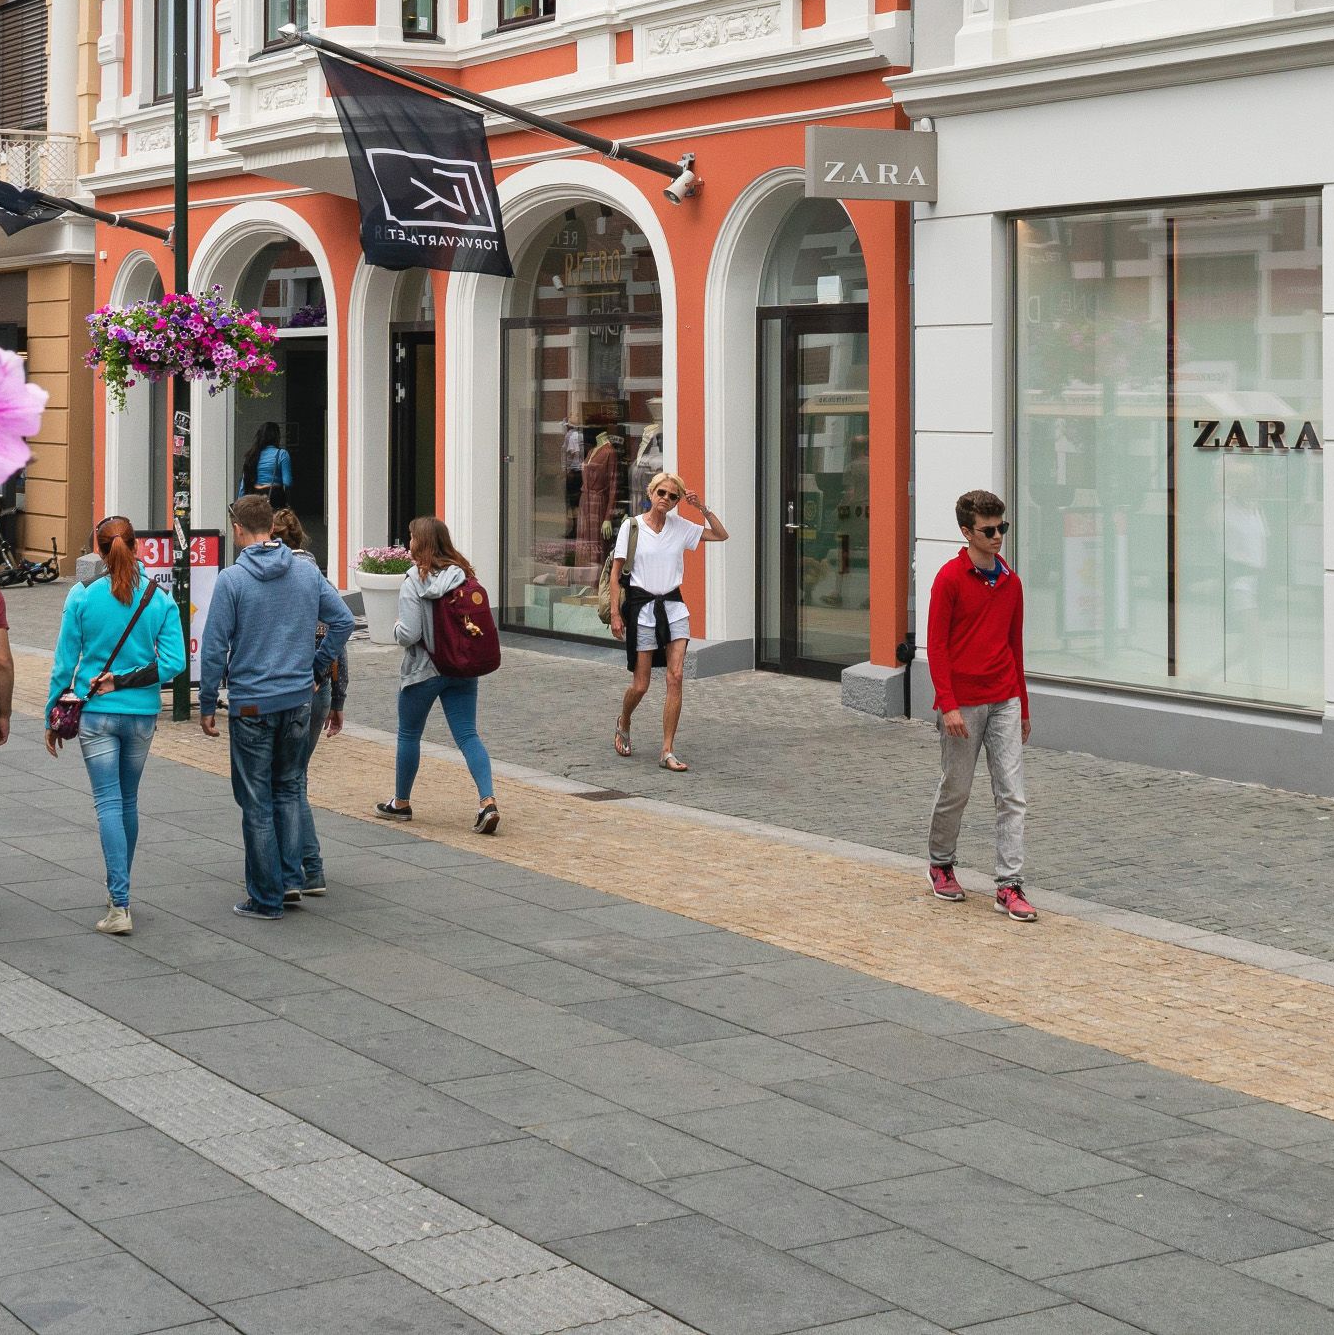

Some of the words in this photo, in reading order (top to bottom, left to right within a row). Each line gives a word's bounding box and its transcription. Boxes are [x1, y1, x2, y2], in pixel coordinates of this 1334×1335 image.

[823, 161, 929, 188] ZARA
[564, 248, 621, 287] RETRO
[1192, 419, 1324, 450] ZARA
[198, 536, 207, 564] AVSLAG
[153, 573, 173, 584] GUL
